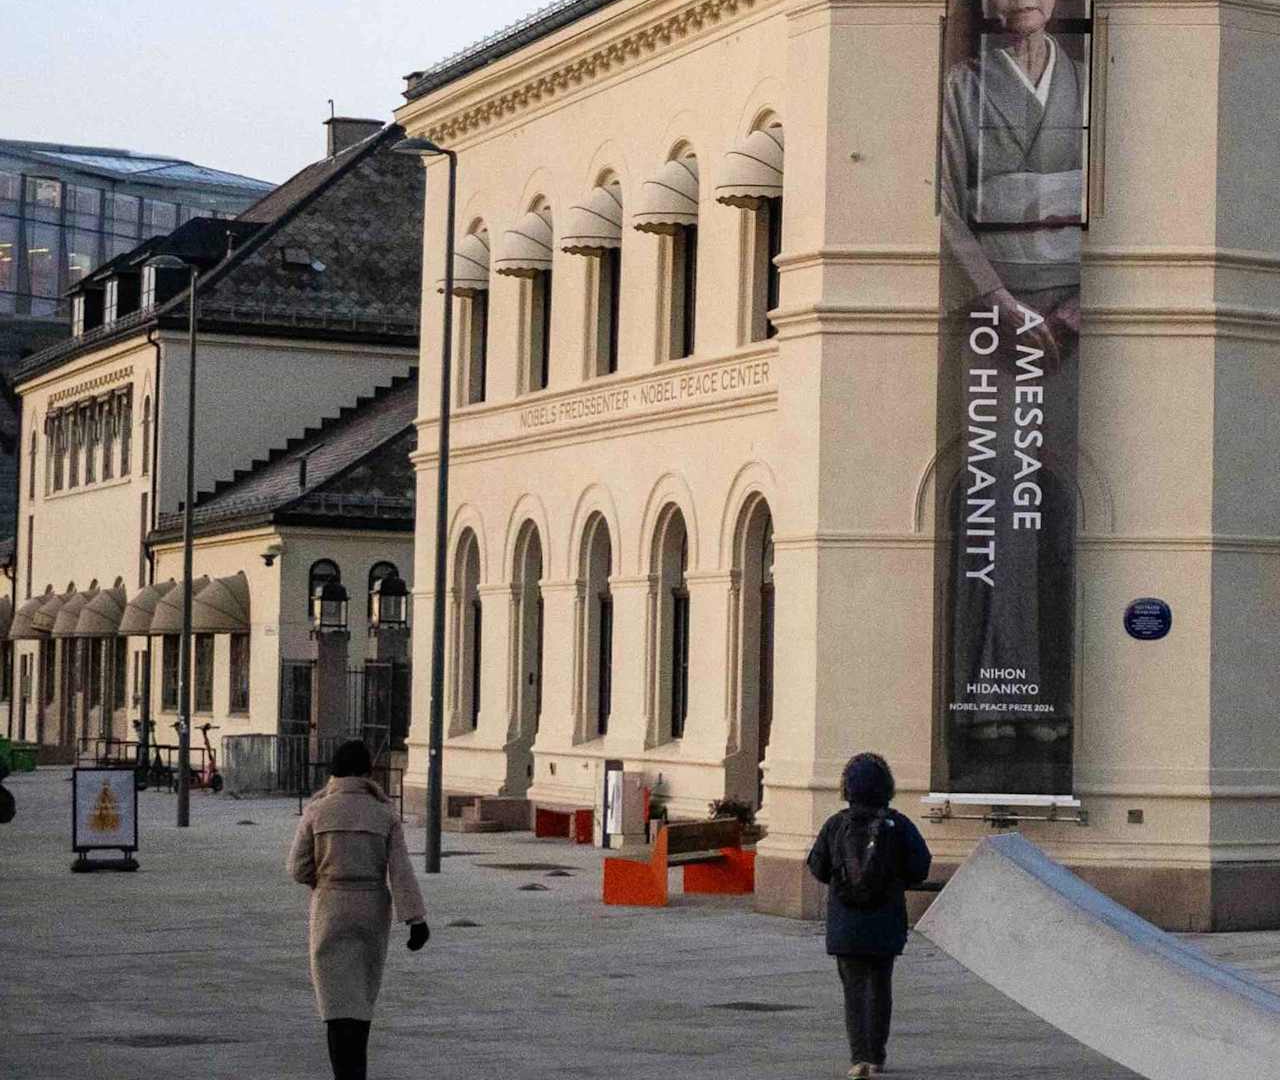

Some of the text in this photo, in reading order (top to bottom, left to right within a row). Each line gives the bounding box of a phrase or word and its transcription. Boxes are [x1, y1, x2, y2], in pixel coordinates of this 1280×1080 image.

[520, 362, 770, 428] NOBELS FREDSSENTER NOBEL PEACE CENTER
[1012, 304, 1044, 530] A MESSAGE
[965, 305, 999, 587] TO HUMANITY
[966, 683, 1039, 695] HIDANKYO
[980, 668, 1026, 679] NIHON
[949, 703, 1055, 712] NOBEL PEACE PRIZE 2024
